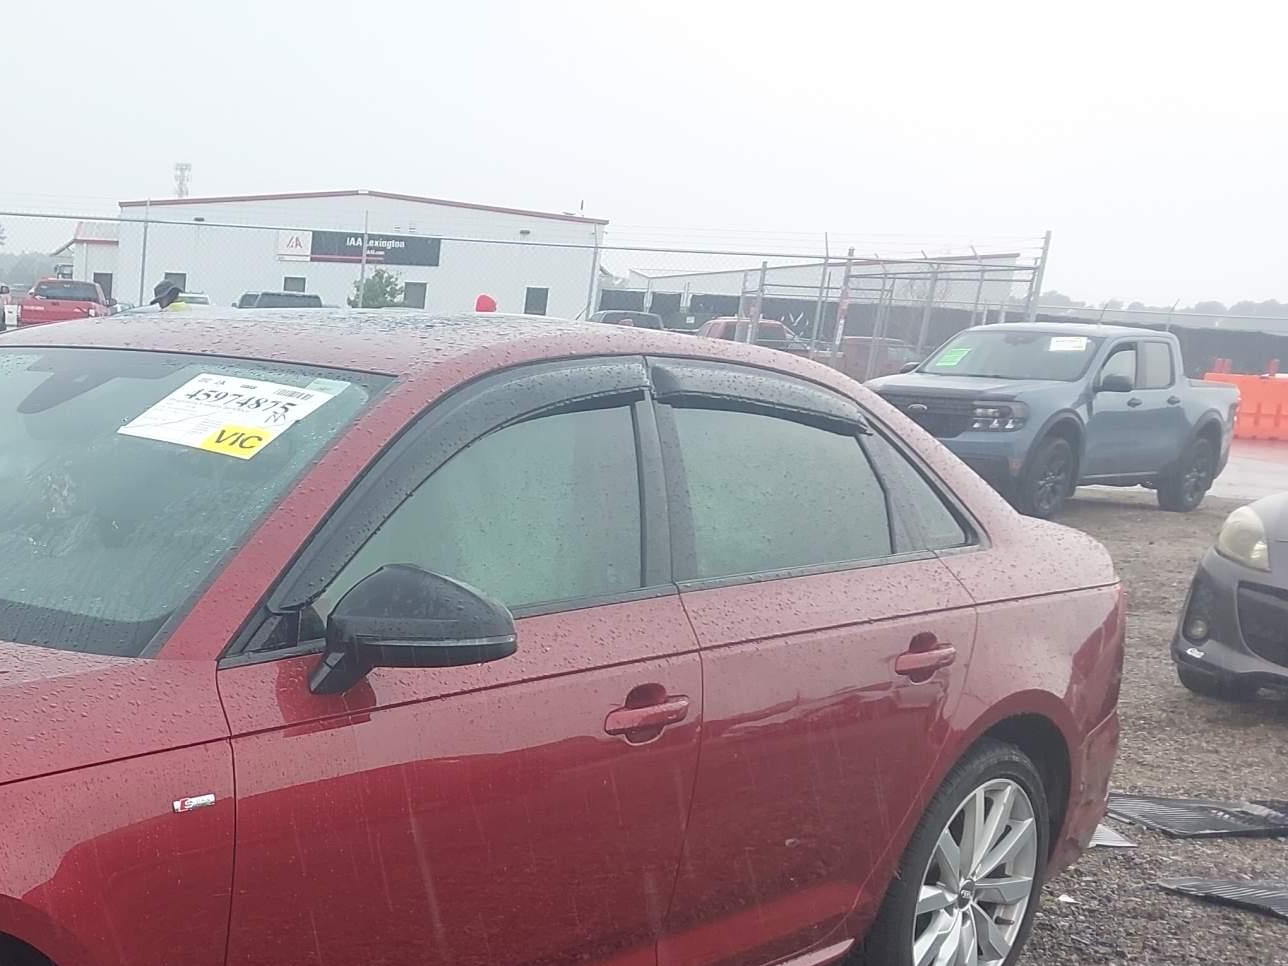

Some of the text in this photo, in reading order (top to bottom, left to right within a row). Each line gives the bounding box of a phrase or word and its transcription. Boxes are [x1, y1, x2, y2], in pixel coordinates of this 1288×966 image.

[346, 236, 363, 247] IAA
[186, 388, 296, 414] 45974875
[215, 429, 263, 449] VIC
